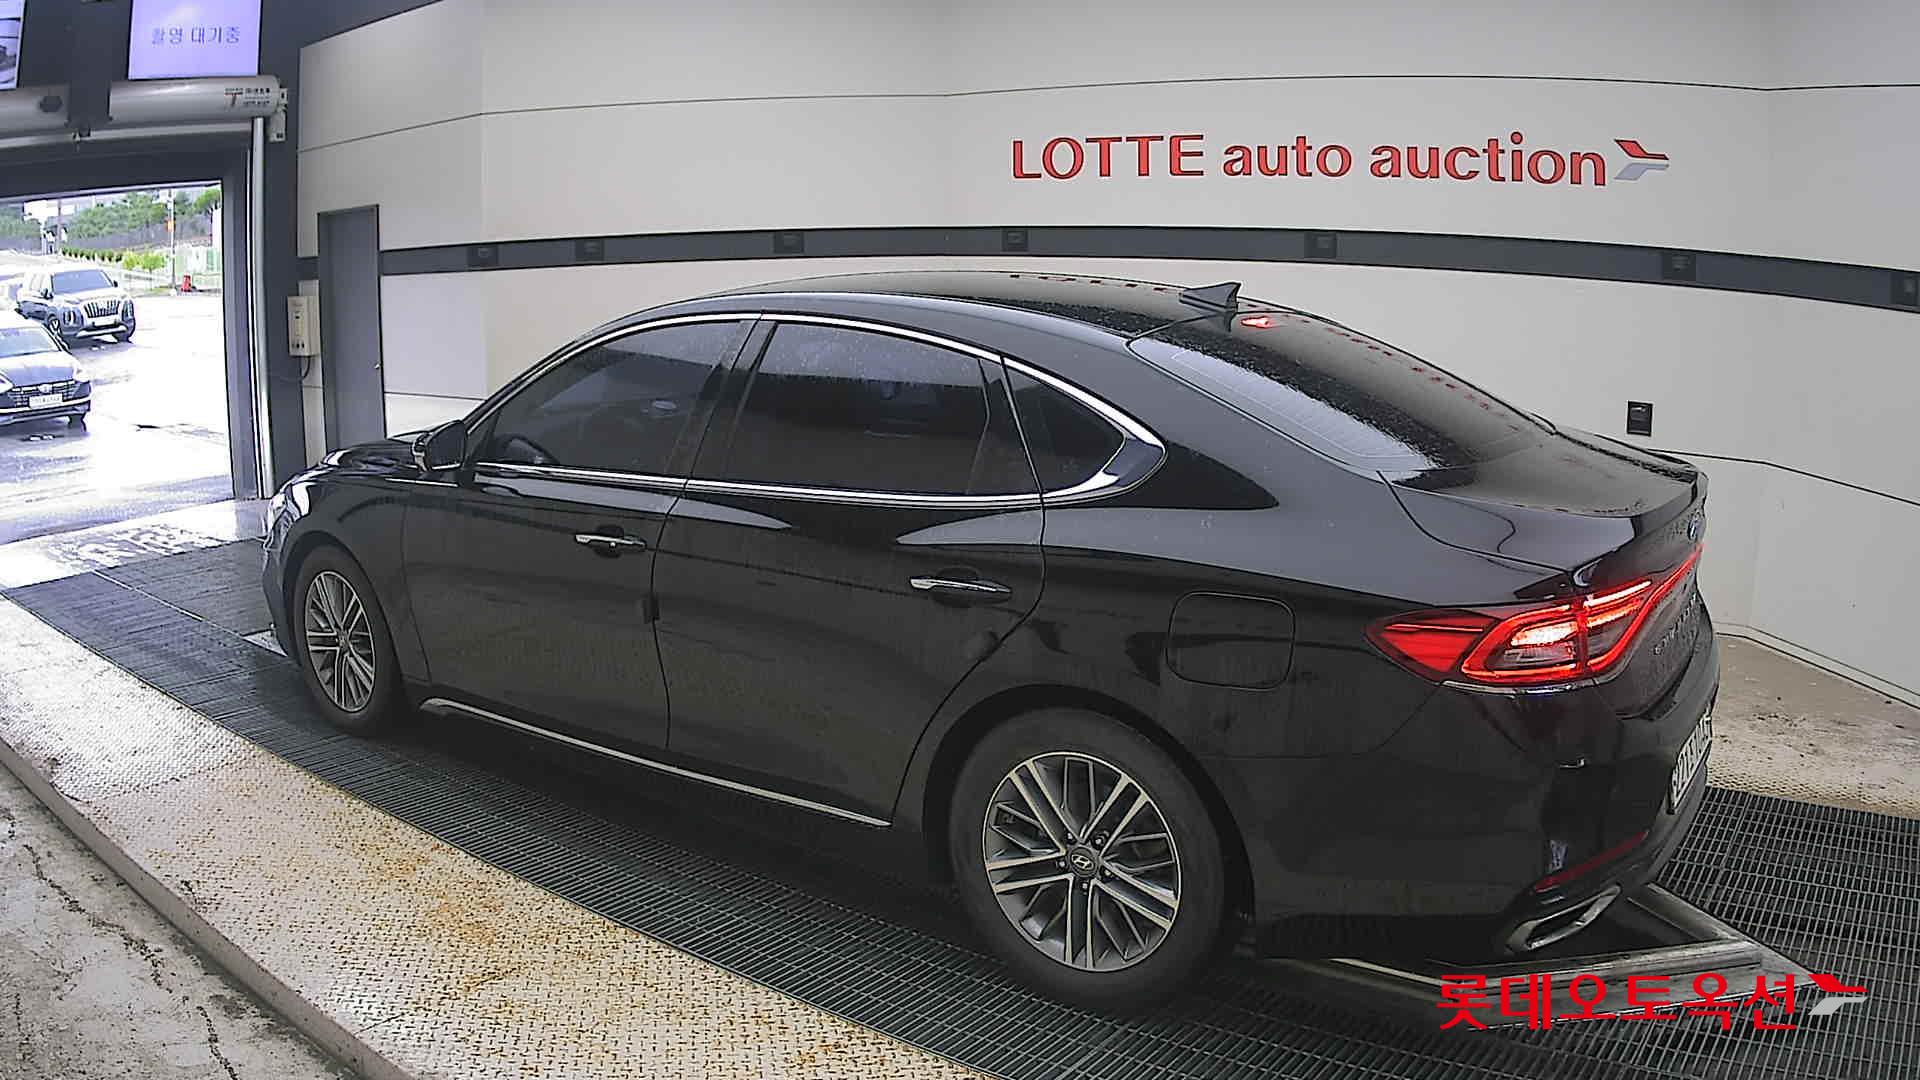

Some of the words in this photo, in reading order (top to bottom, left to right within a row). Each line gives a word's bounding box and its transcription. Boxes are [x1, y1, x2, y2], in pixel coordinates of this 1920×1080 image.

[191, 25, 240, 44] 대기중
[1012, 134, 1206, 179] LOTTE
[1223, 136, 1353, 177] auto
[1370, 132, 1607, 186] auction
